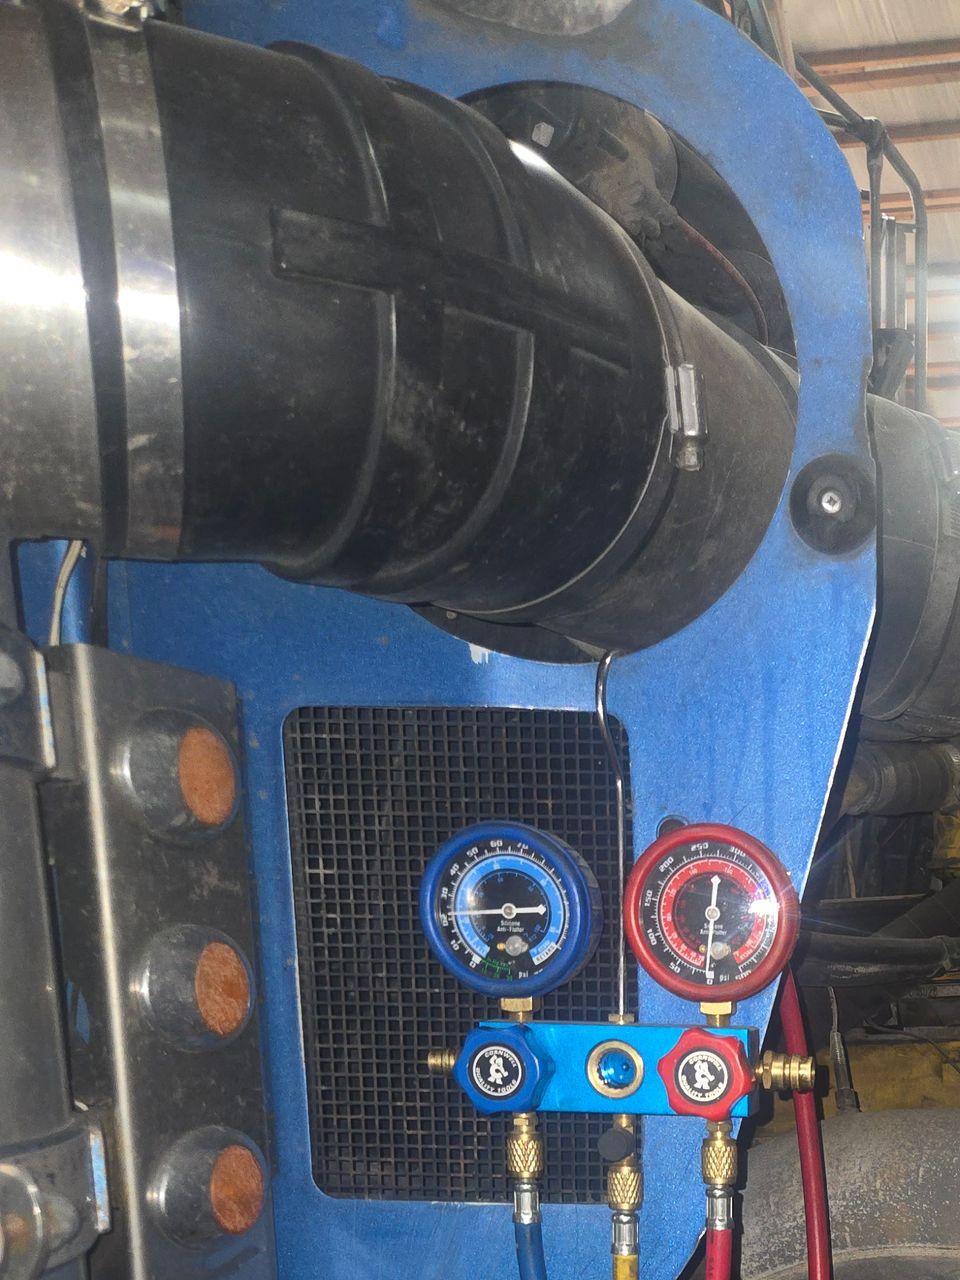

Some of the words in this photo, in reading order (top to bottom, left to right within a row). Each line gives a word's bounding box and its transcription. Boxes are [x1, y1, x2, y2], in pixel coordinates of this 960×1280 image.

[489, 840, 503, 848] 60
[690, 842, 710, 852] 250
[466, 846, 479, 858] 50
[449, 863, 460, 876] 40
[658, 856, 674, 873] 200
[644, 889, 653, 907] 150
[647, 928, 658, 946] 100
[450, 939, 460, 951] 10
[469, 961, 477, 969] 0
[668, 961, 681, 974] 50
[518, 970, 529, 980] psi
[719, 973, 730, 983] psi
[706, 978, 714, 986] 0
[484, 1049, 518, 1068] CORNWELL
